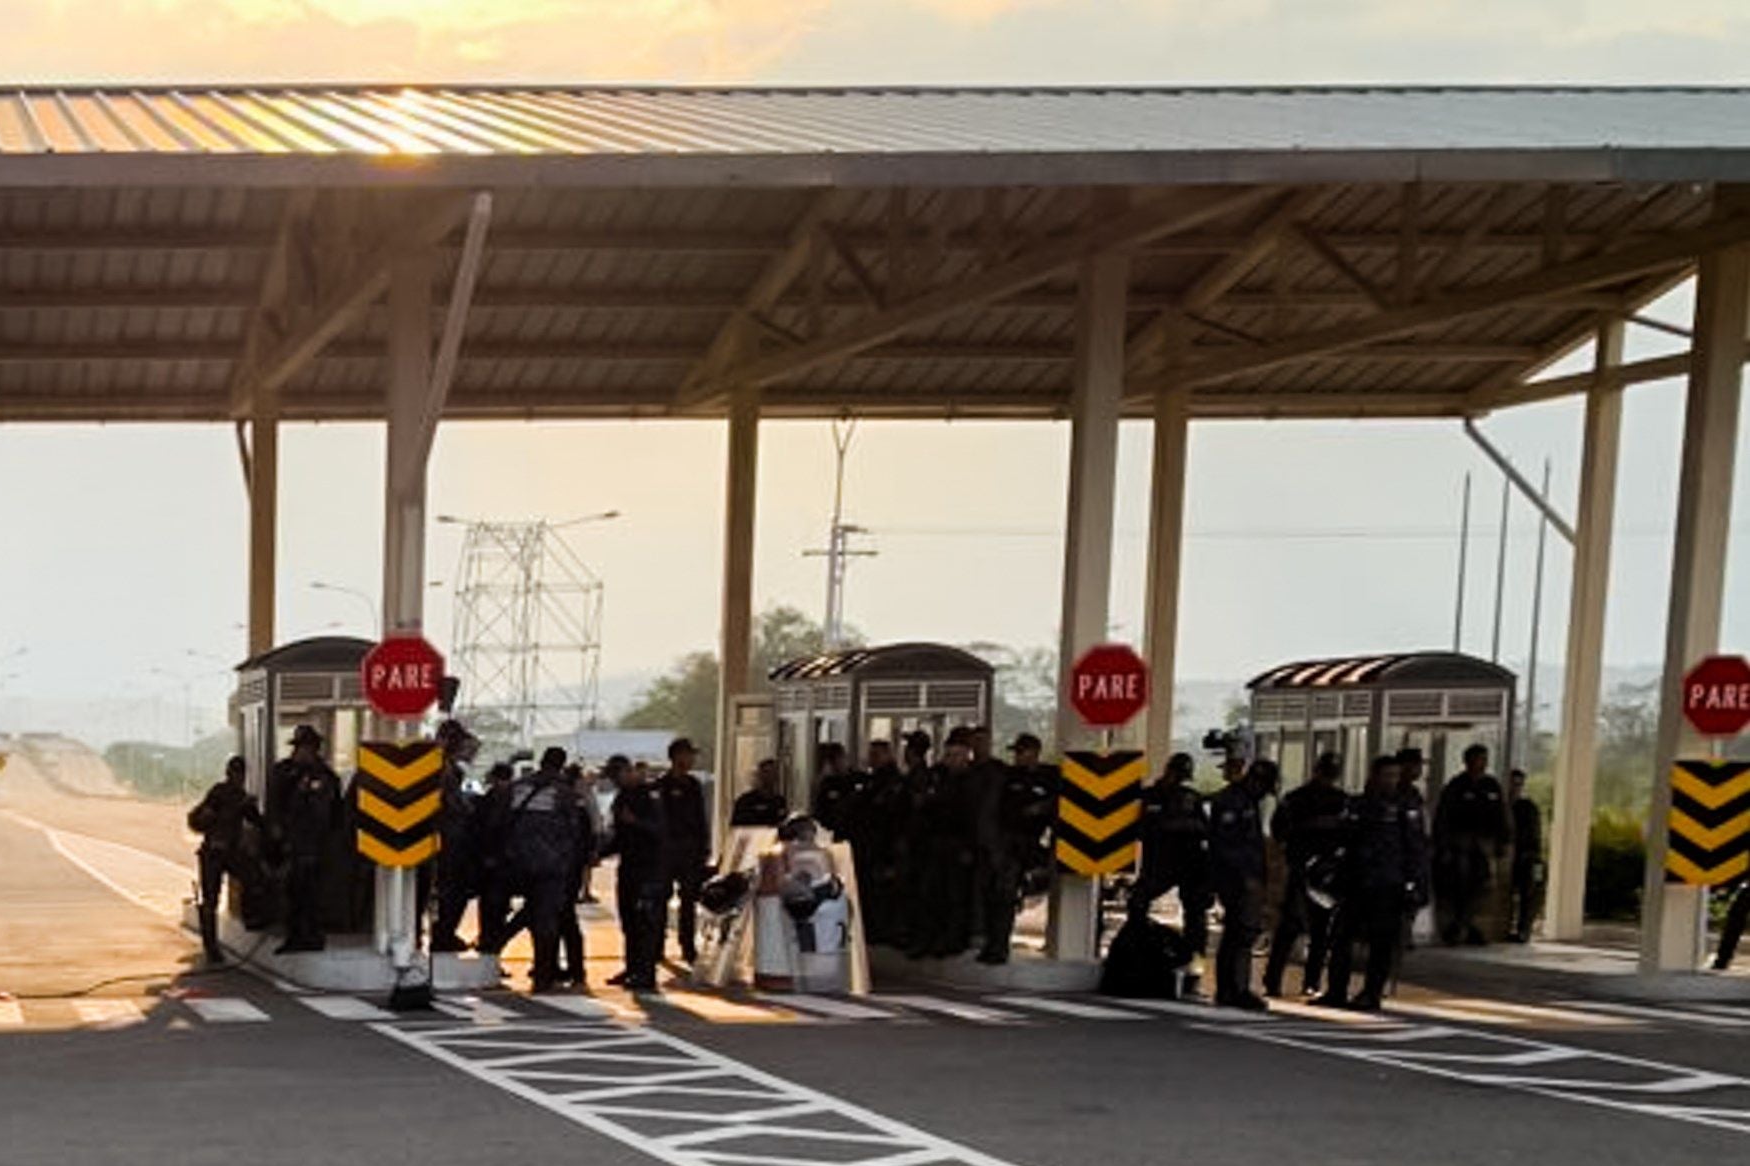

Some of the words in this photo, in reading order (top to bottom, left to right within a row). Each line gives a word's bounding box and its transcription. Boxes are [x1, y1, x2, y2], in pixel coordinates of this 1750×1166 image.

[371, 664, 434, 690] PARE
[1078, 674, 1137, 699] PARE
[1689, 683, 1750, 709] PARE
